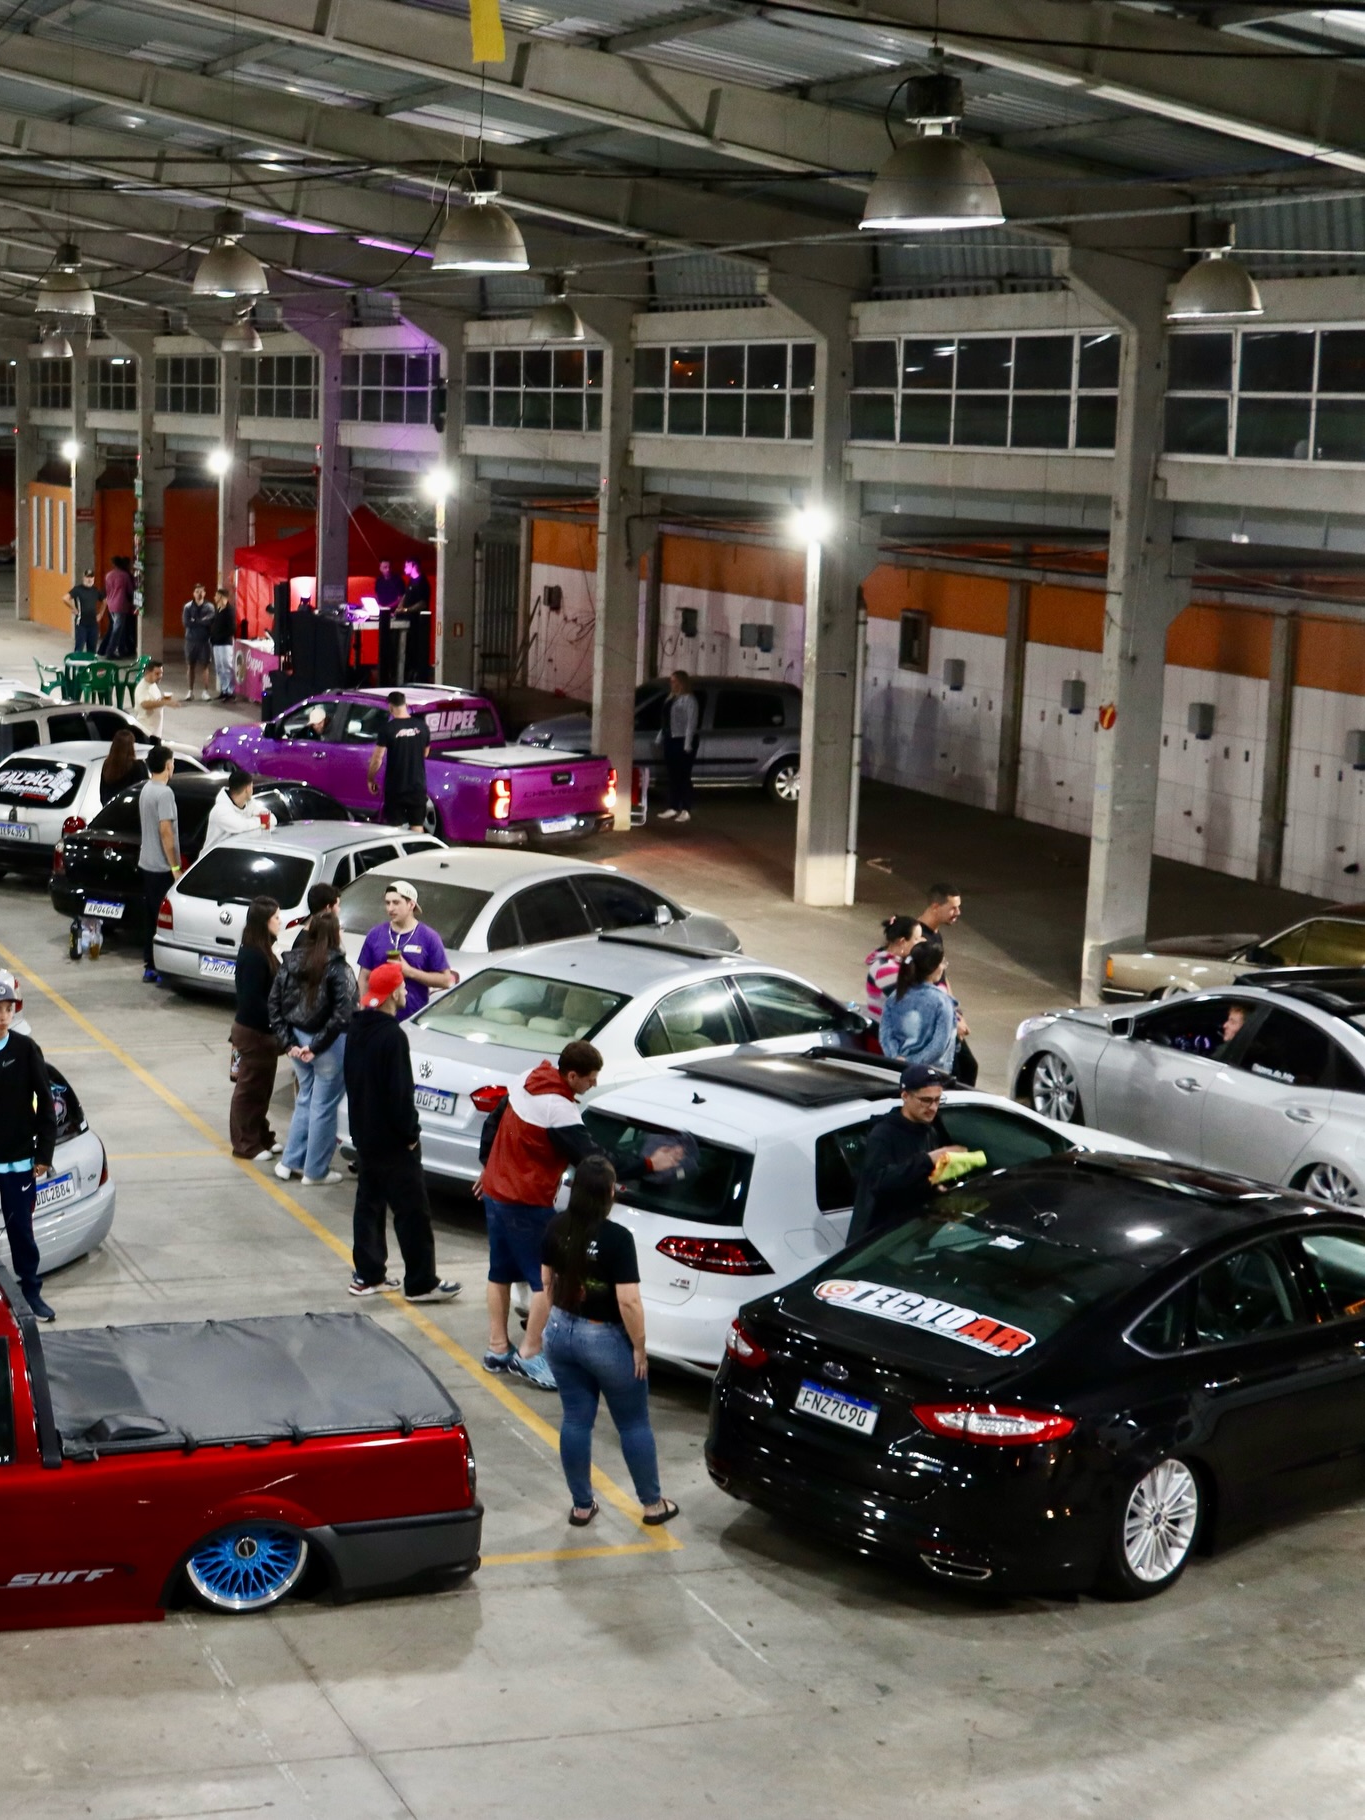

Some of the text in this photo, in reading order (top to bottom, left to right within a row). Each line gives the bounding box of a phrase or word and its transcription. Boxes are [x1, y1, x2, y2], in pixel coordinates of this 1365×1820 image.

[204, 960, 236, 976] IJW9G1
[851, 1284, 1033, 1353] TECNOAR
[801, 1390, 868, 1428] FNZ7C90
